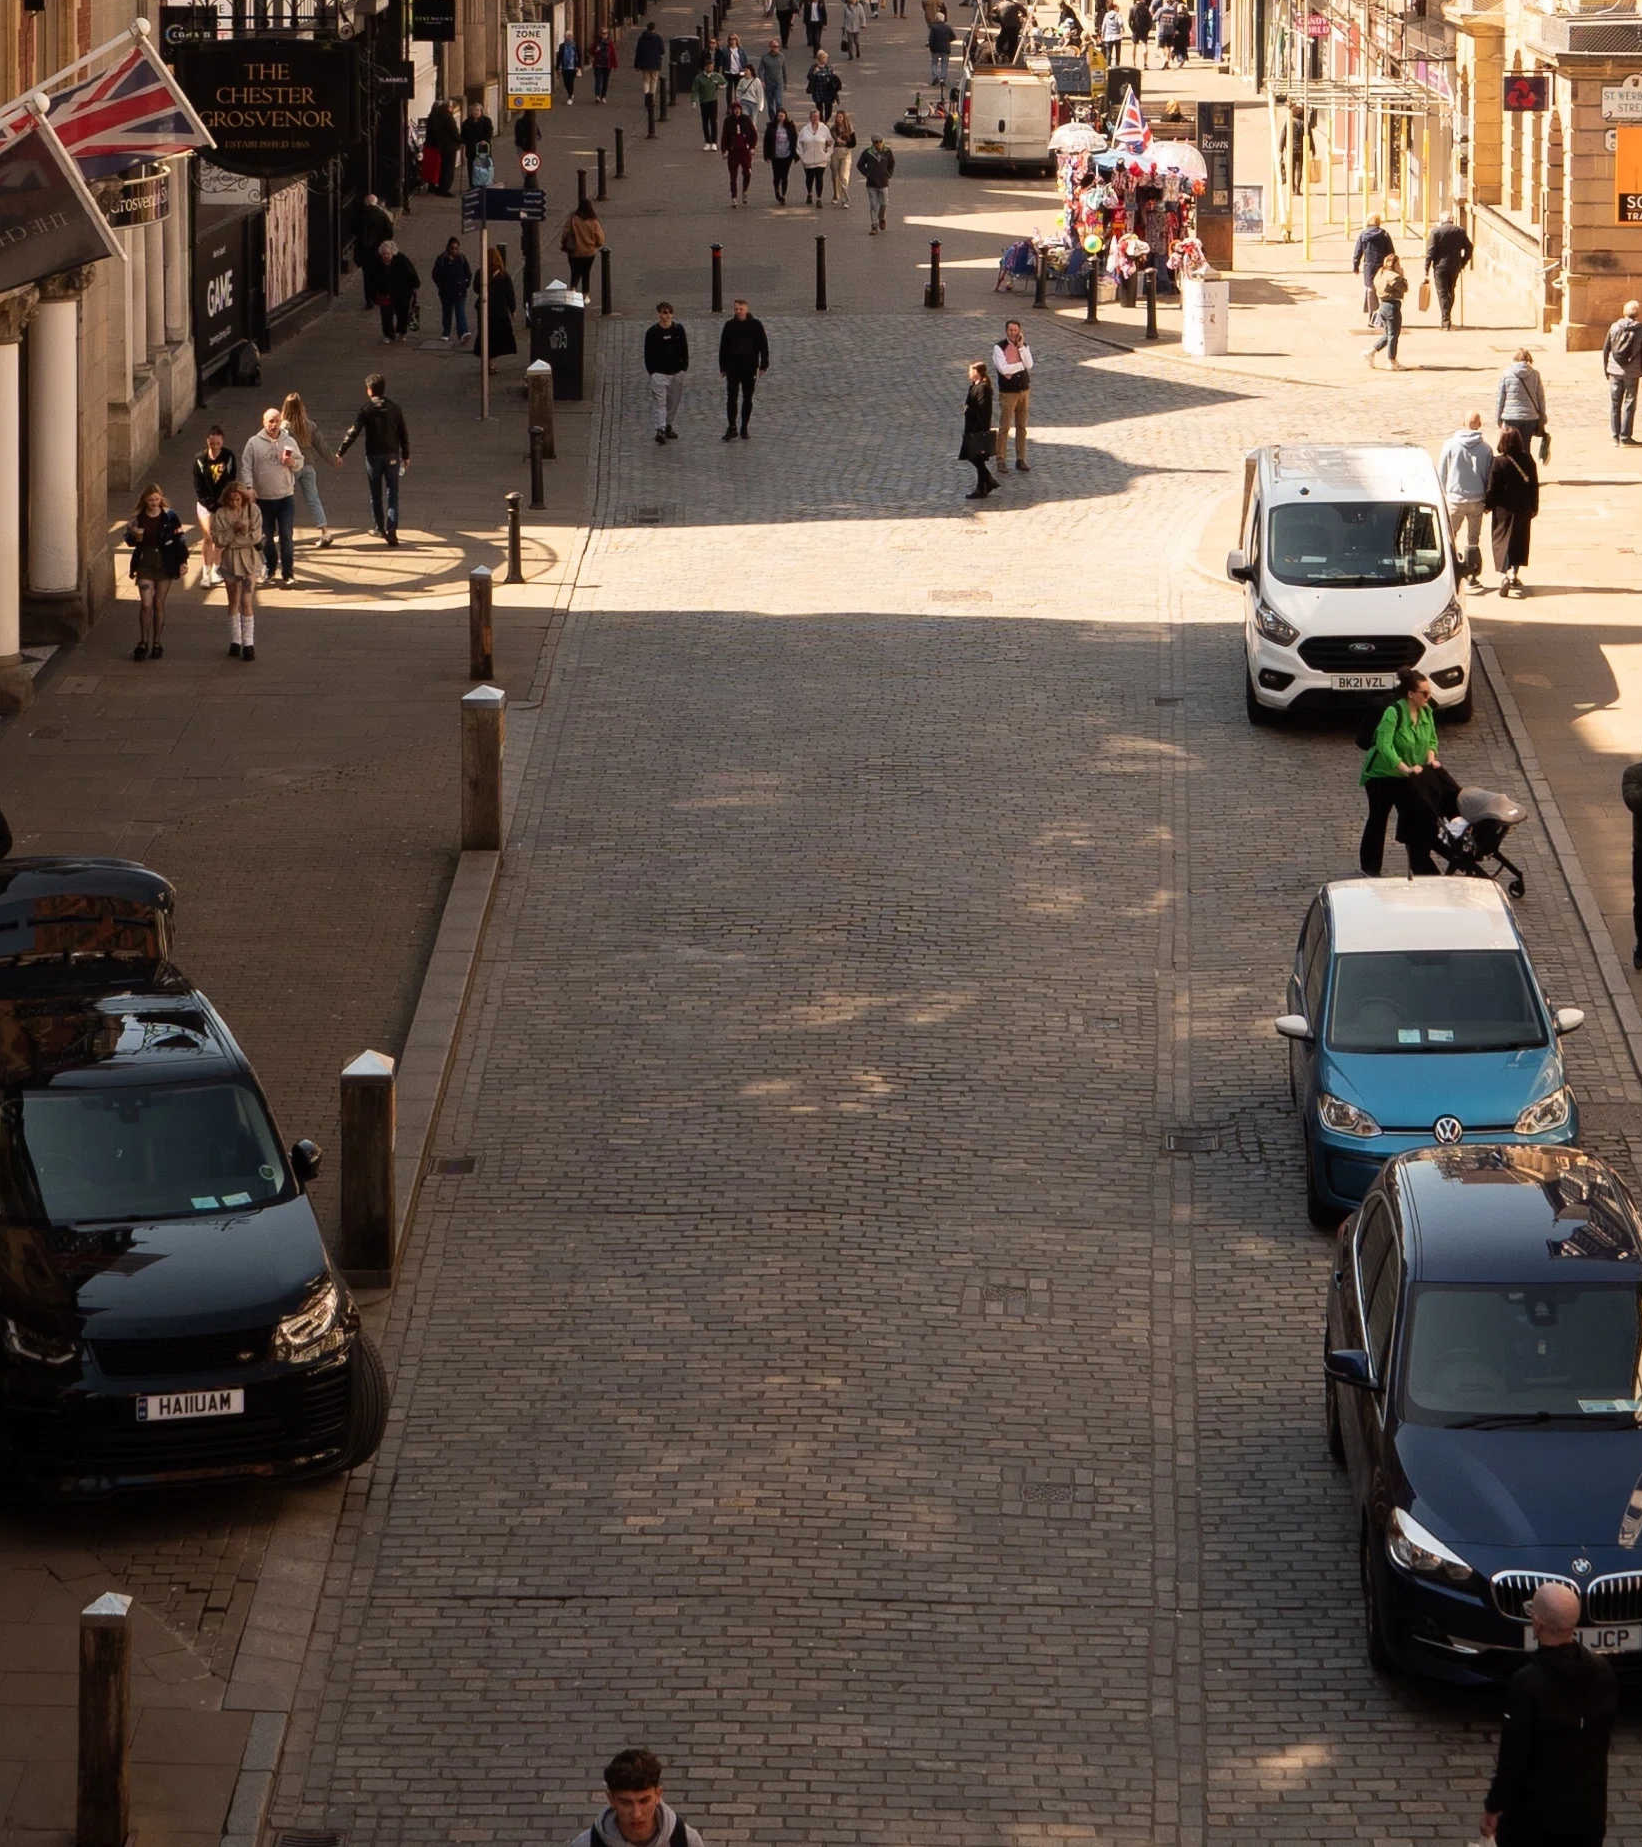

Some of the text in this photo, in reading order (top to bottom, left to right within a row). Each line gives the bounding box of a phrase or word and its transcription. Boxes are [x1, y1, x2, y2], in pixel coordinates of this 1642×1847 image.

[243, 63, 290, 81] THE
[216, 87, 316, 105] CHESTER
[1604, 91, 1616, 101] ST.
[200, 110, 335, 129] GROSVENOR
[225, 140, 290, 150] ESTABLISHED
[524, 158, 538, 167] 20
[207, 269, 233, 318] GAME
[1339, 676, 1386, 689] BK21 VZL
